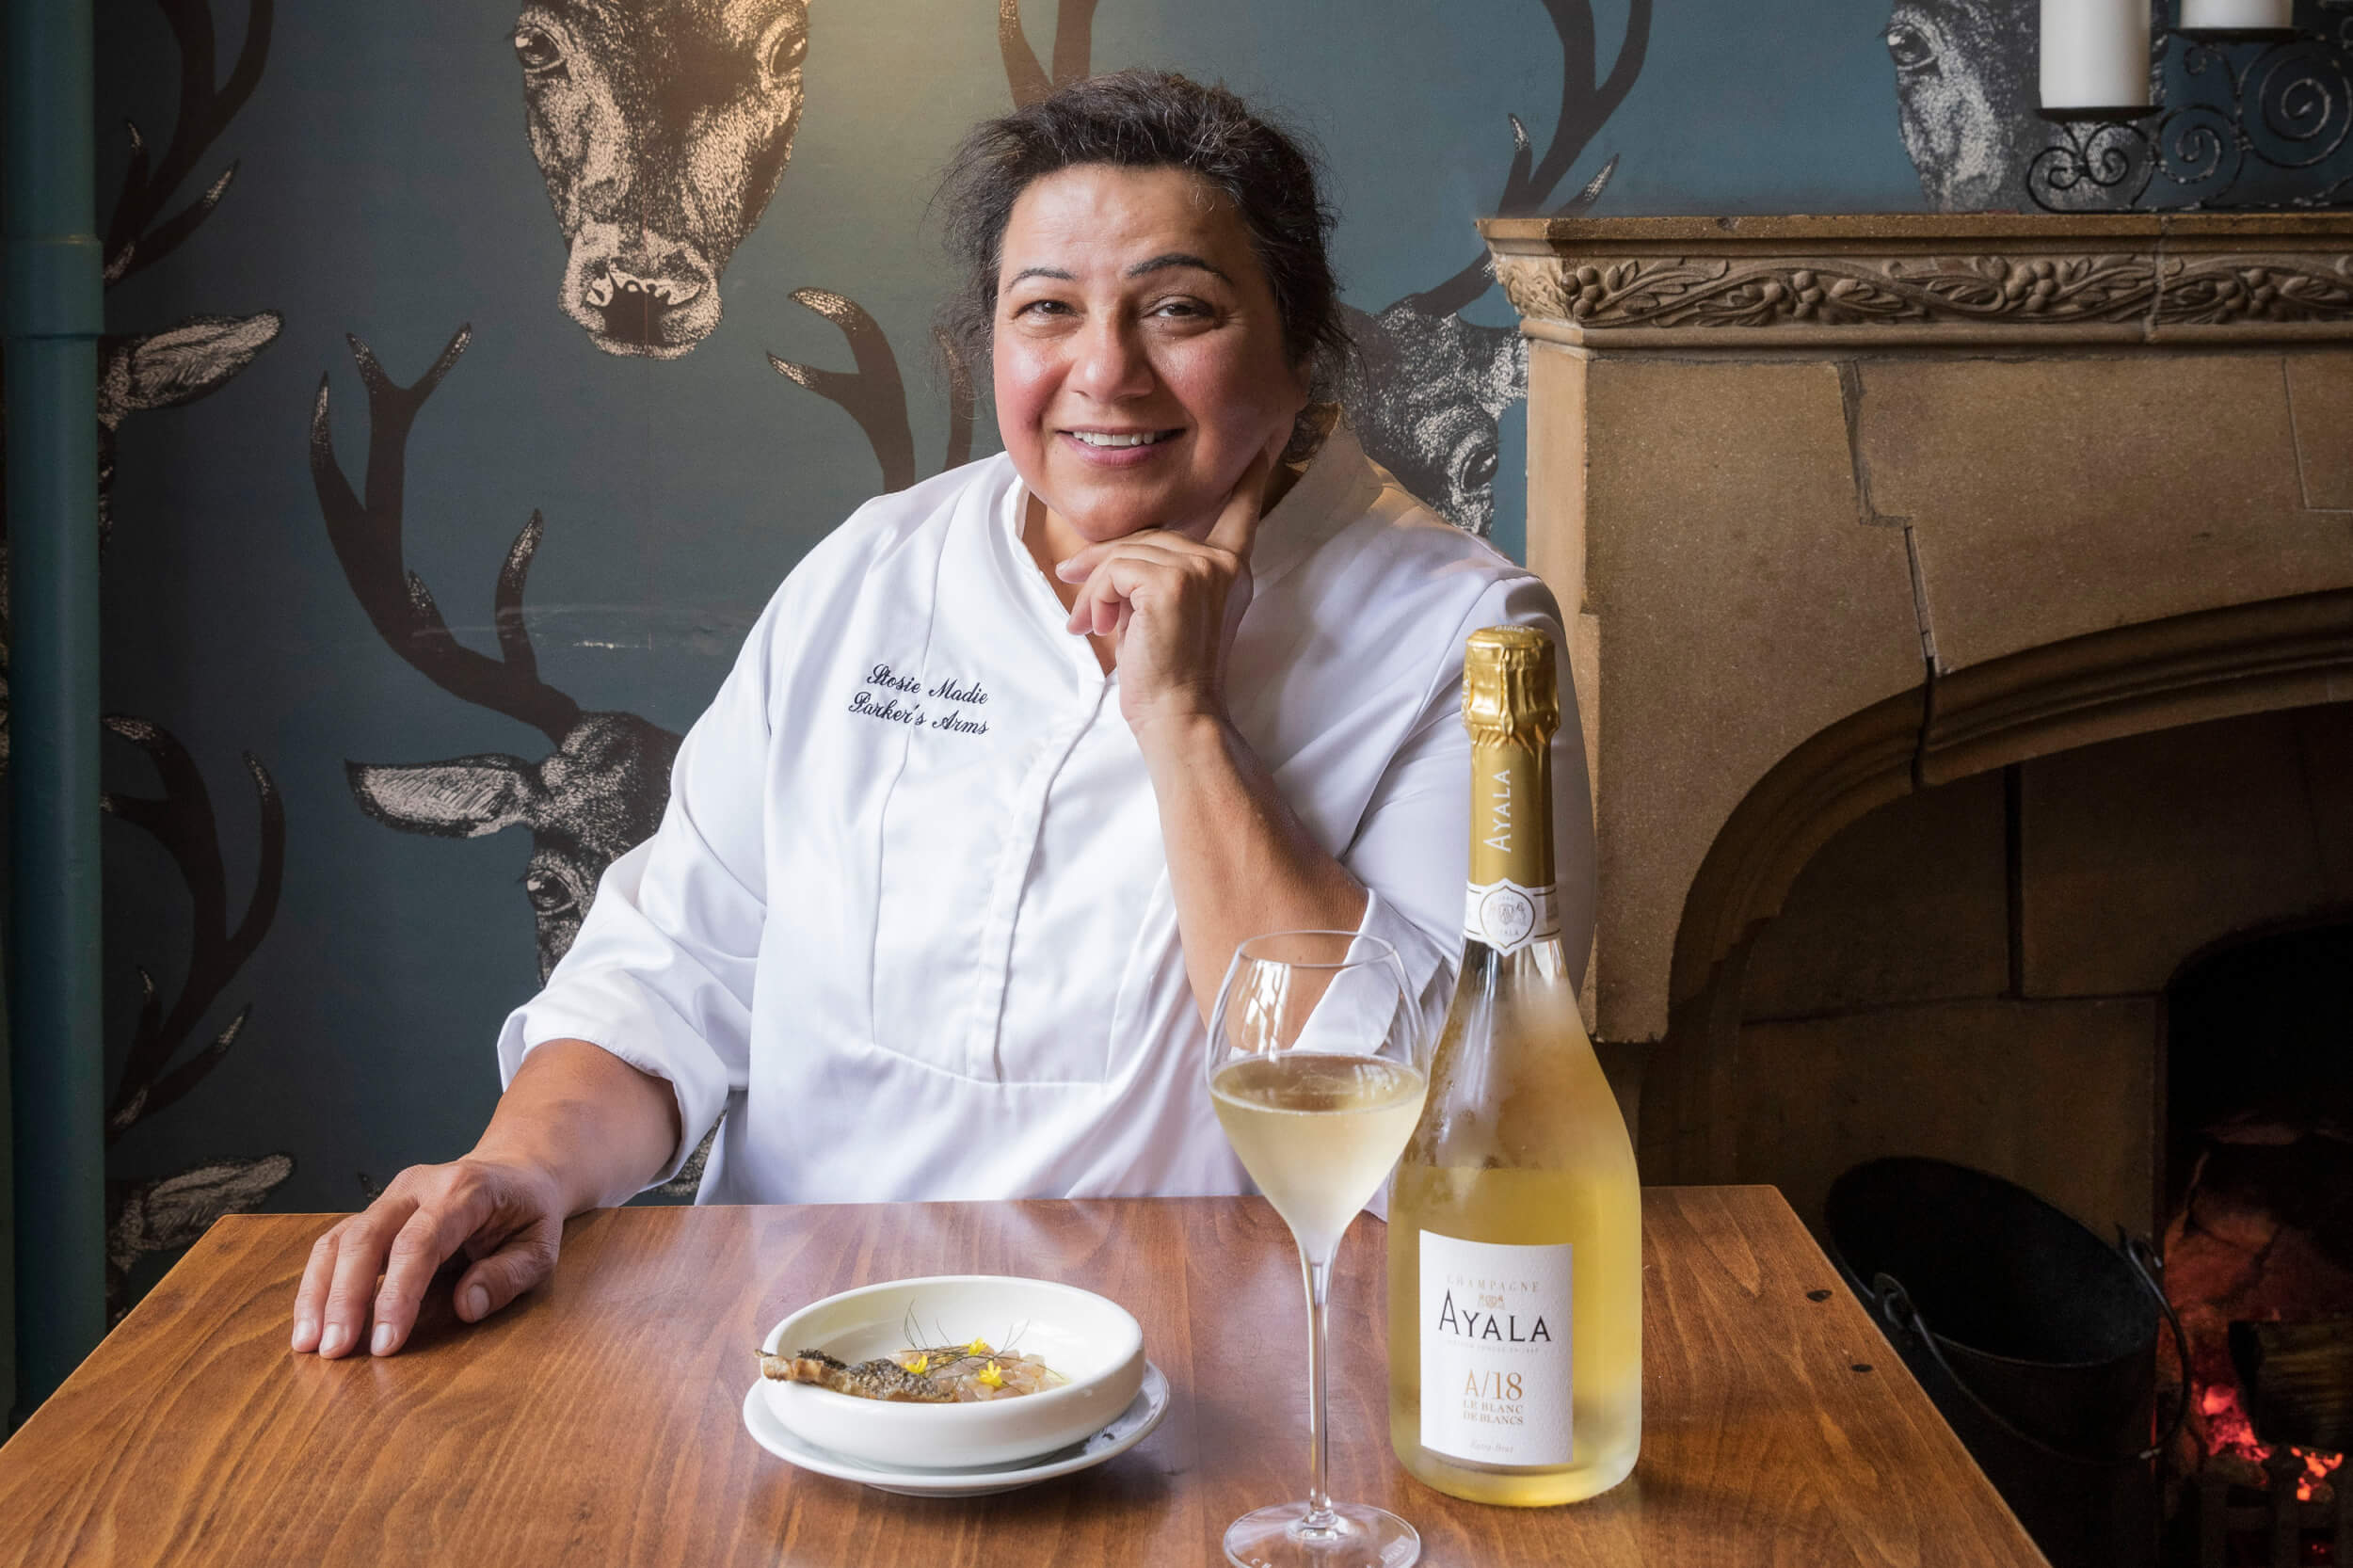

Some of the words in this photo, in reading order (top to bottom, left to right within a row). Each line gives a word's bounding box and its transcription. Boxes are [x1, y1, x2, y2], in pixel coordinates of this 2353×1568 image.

[867, 664, 921, 694] Stosie
[928, 678, 988, 704] Madie
[848, 691, 926, 726] Parker's
[932, 710, 989, 735] Arms
[1483, 769, 1512, 853] AYALA
[1447, 1275, 1540, 1293] CHAMPAGNE
[1439, 1288, 1552, 1342] AYALA
[1465, 1369, 1523, 1401] A/18
[1464, 1411, 1479, 1422] DE
[1480, 1413, 1524, 1425] BLANCS
[1481, 1401, 1523, 1415] BLANC
